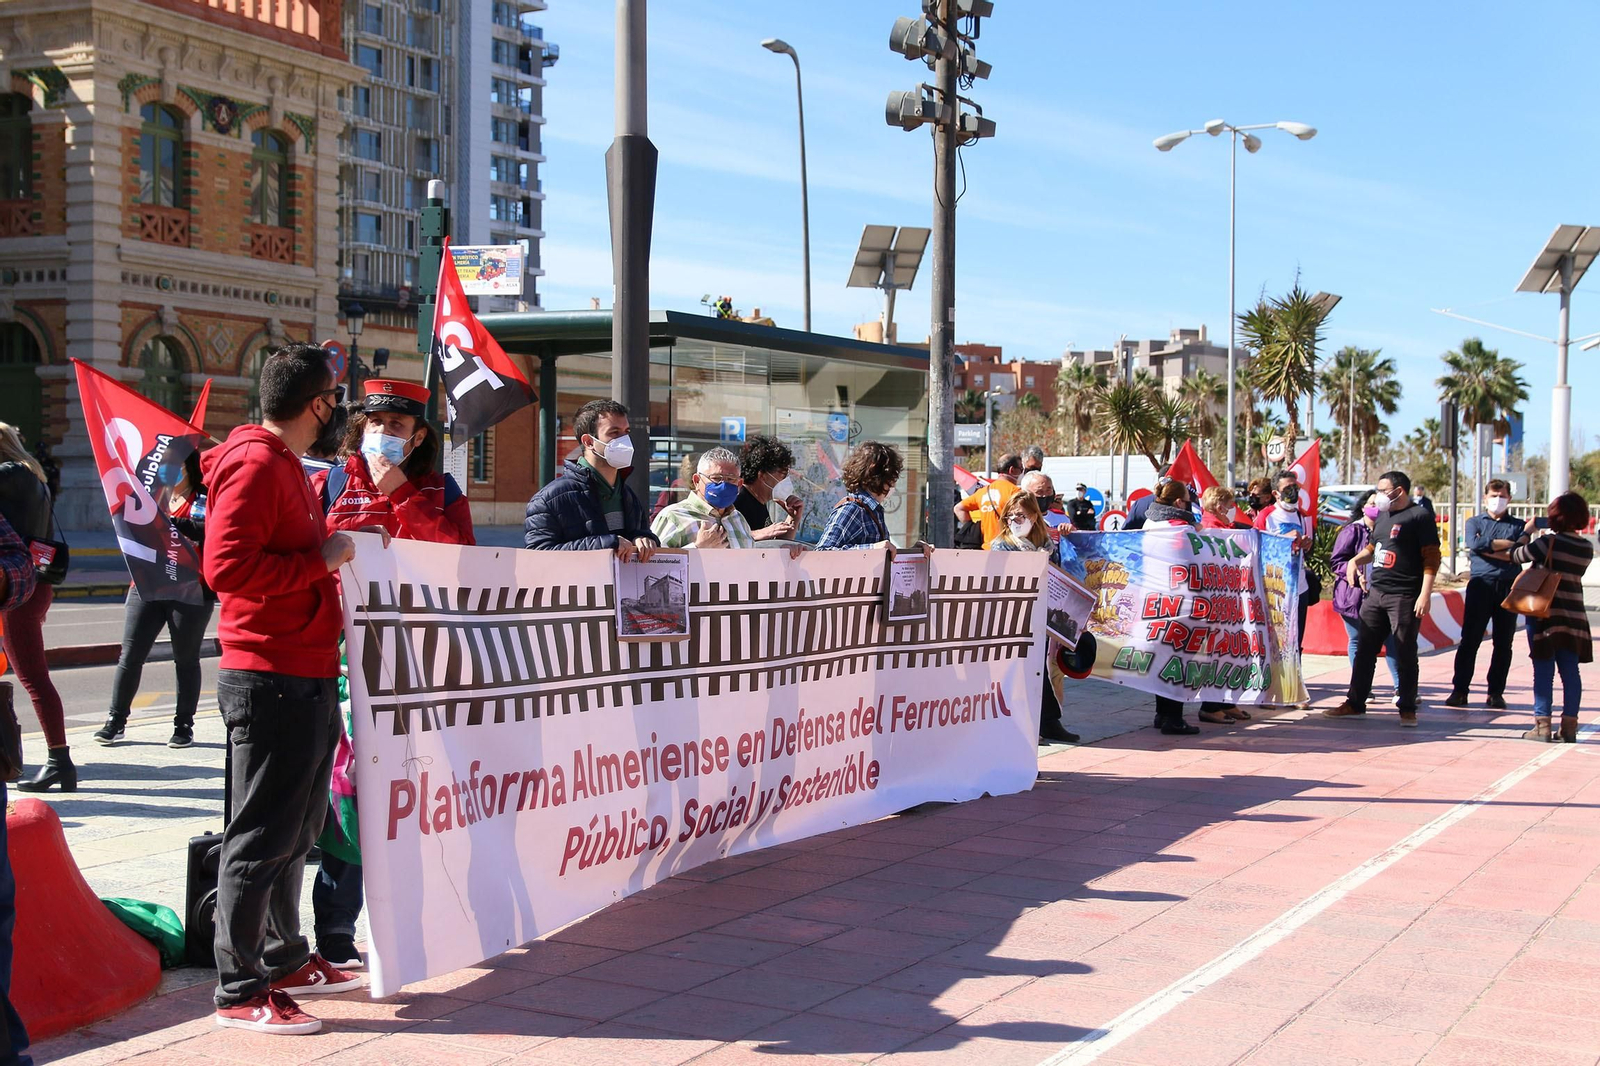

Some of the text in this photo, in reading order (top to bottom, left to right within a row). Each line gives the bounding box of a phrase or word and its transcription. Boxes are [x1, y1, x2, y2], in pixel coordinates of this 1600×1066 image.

[958, 430, 981, 438] Parking
[1269, 443, 1281, 455] 20
[1169, 564, 1257, 594] PLATAFORMA
[1142, 593, 1182, 619] EN
[1191, 594, 1245, 625] DEFENSA
[1112, 646, 1272, 691] EN ANALUCÍA
[387, 681, 1012, 841] Plataforma Almeriense en Defensa del Ferrocarril
[559, 750, 880, 877] Público, Social y Sostenible
